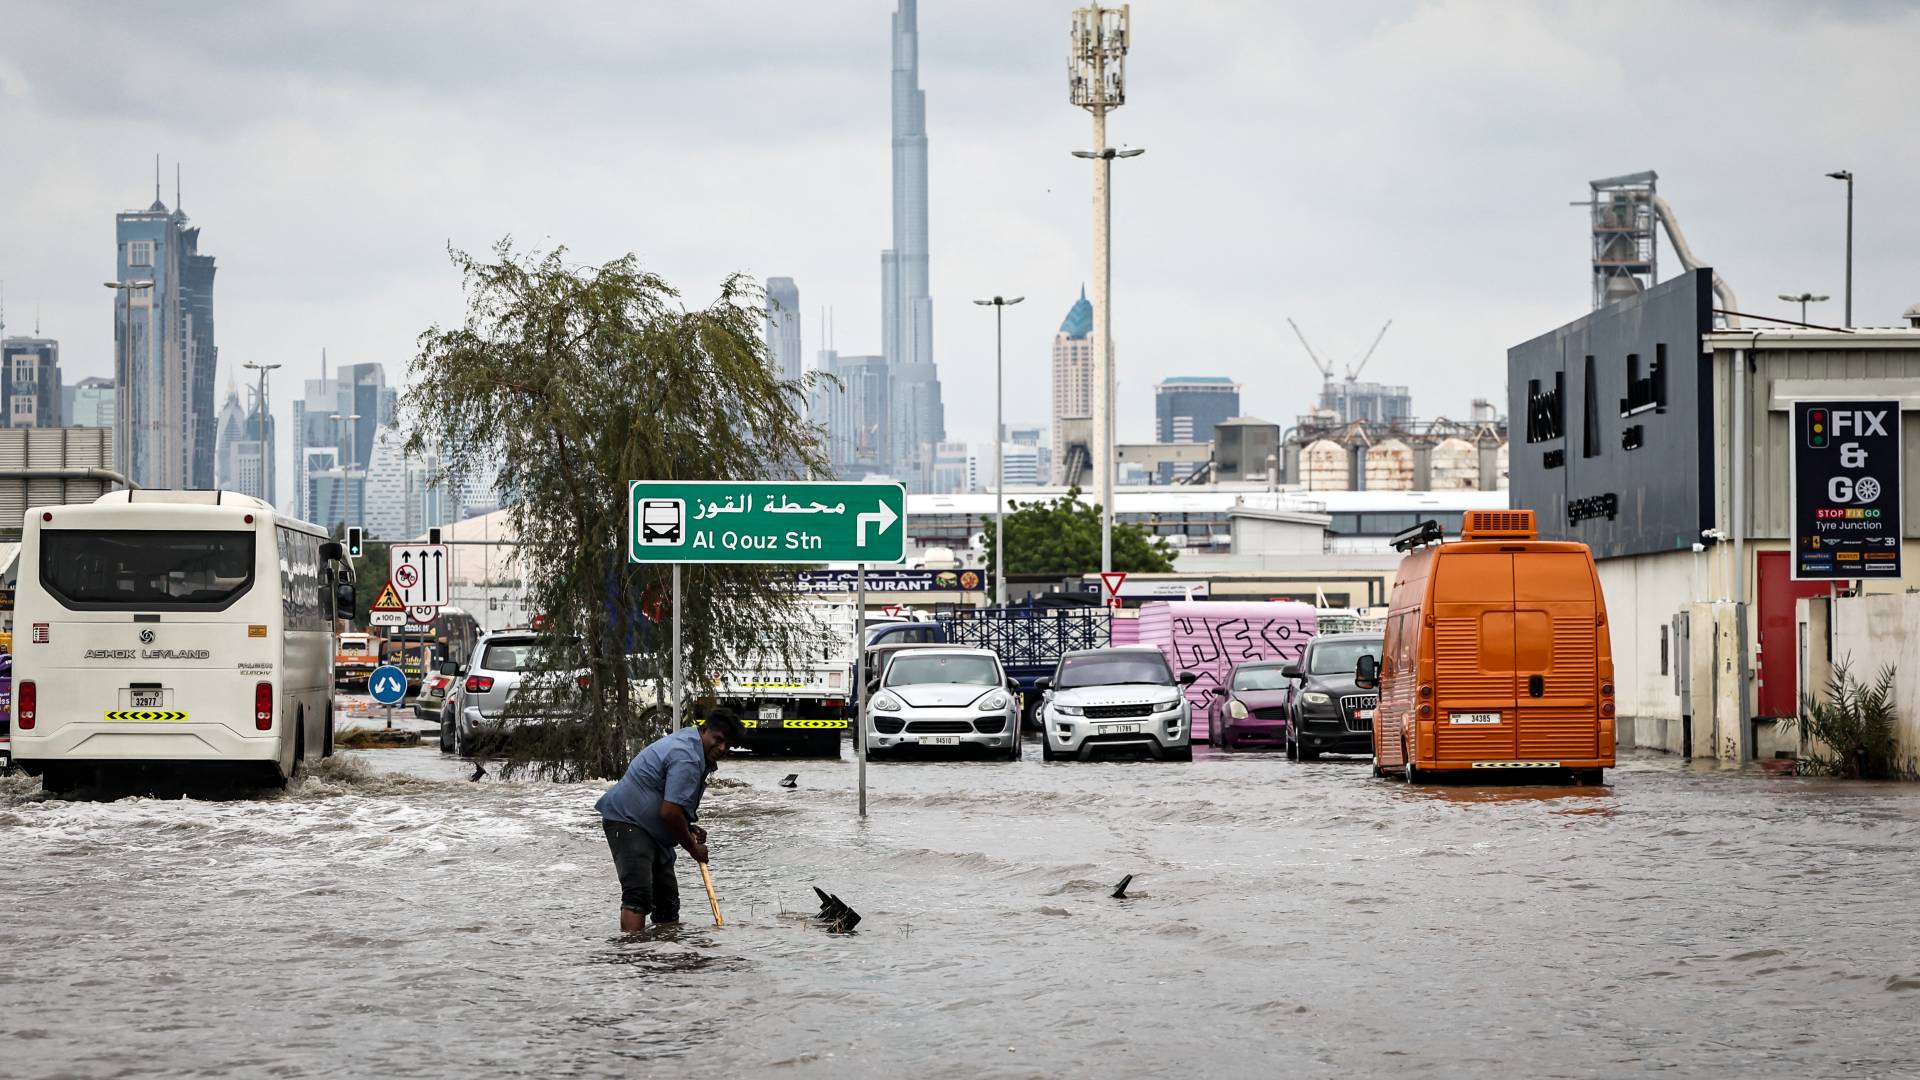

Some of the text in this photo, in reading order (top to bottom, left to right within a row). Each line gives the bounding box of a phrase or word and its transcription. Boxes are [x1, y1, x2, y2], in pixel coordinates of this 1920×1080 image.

[1831, 410, 1889, 437] FIX
[1840, 442, 1868, 468] &
[693, 494, 847, 520] محطة القوز
[1817, 509, 1844, 518] STOP
[1864, 509, 1880, 518] GO
[1816, 521, 1882, 532] Tyre Junction
[692, 531, 822, 550] Al Qouz Stn
[815, 580, 933, 592] RESTAURANT
[416, 606, 432, 616] 60
[381, 614, 394, 622] 100
[84, 649, 210, 659] ASHOK LEYLAND
[135, 697, 157, 706] 32977
[1471, 714, 1491, 723] 34385
